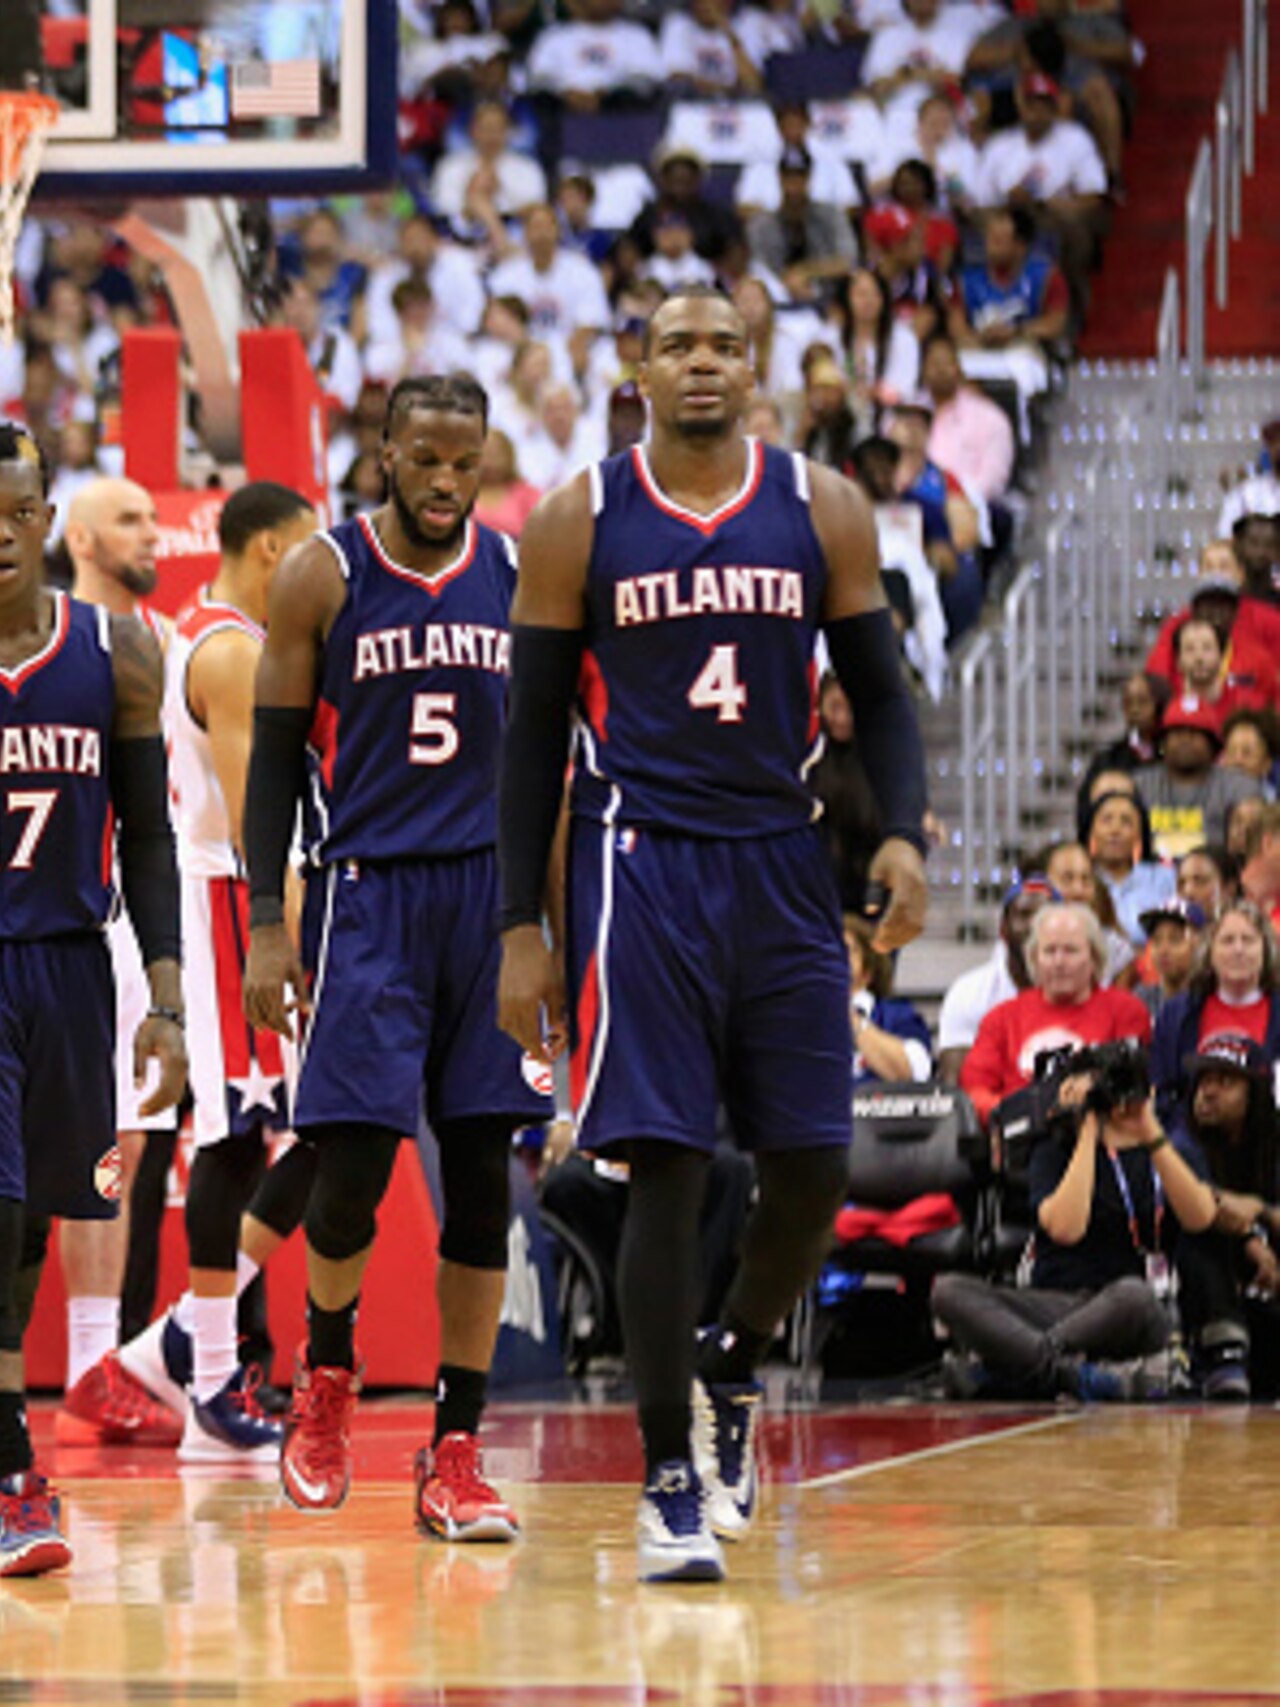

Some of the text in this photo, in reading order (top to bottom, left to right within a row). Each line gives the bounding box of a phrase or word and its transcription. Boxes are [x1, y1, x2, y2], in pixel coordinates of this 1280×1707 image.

[613, 565, 804, 627] ATLANTA
[352, 623, 512, 683] ATLANTA
[687, 643, 747, 724] 4
[407, 692, 461, 765] 5
